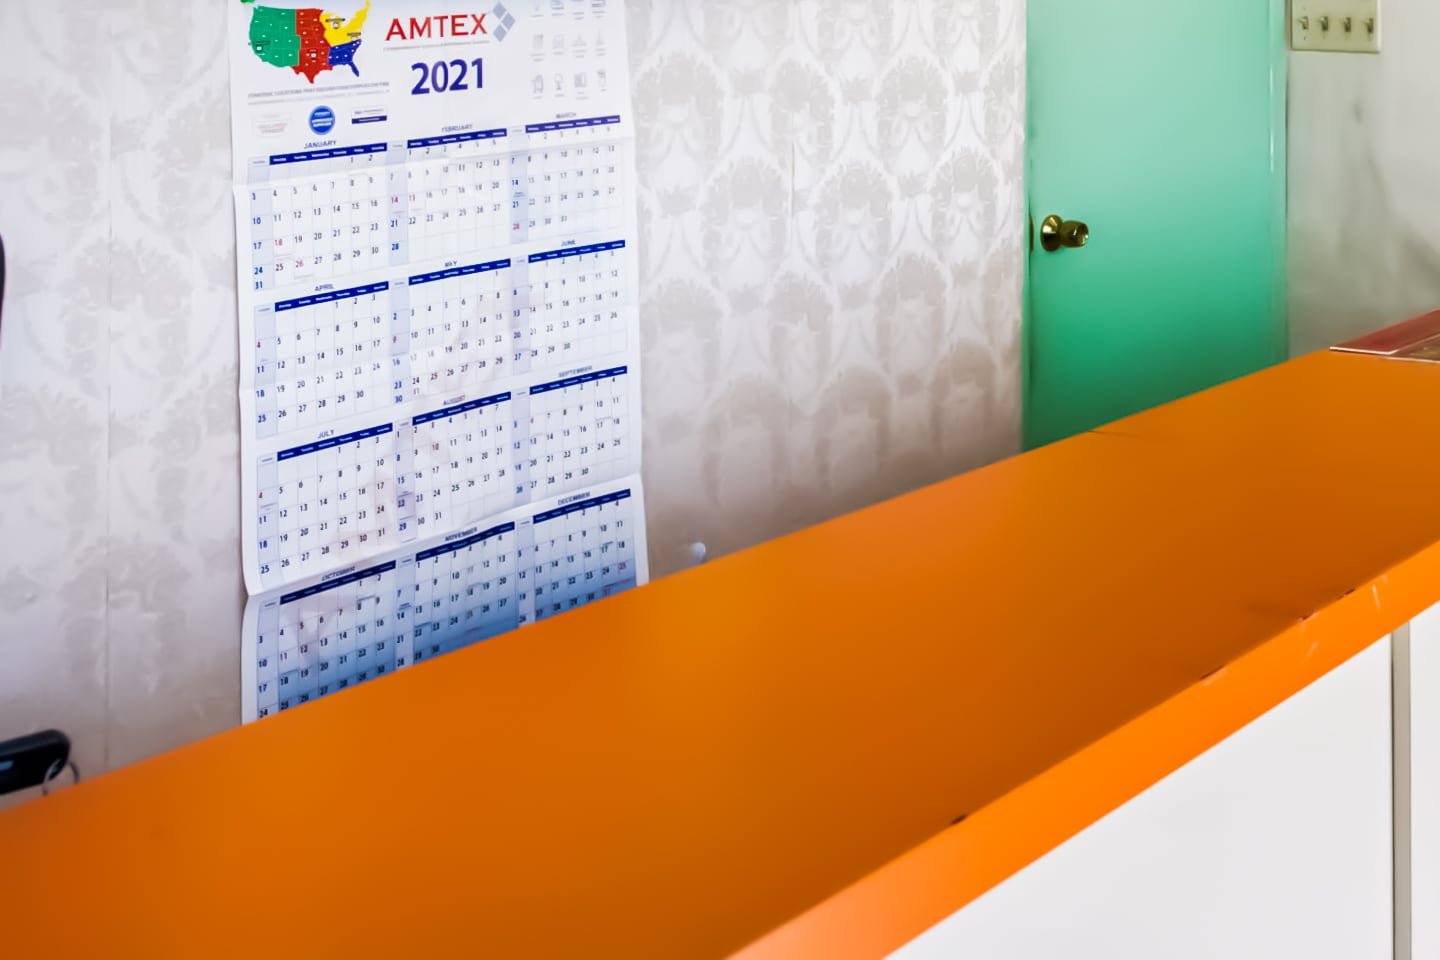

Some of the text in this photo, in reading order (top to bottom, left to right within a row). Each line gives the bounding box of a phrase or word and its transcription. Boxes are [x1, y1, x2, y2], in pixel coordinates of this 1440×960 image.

[384, 13, 487, 41] AMTEX
[411, 57, 483, 96] 2021
[304, 139, 337, 149] JANUARY
[252, 217, 261, 225] 10
[273, 214, 282, 222] 11
[294, 211, 302, 219] 12
[333, 205, 341, 213] 14
[314, 232, 322, 240] 20
[333, 229, 341, 237] 21
[352, 226, 360, 234] 22
[370, 223, 379, 231] 23
[254, 266, 263, 274] 24
[275, 263, 284, 271] 25
[295, 260, 304, 268] 26
[314, 256, 322, 264] 27
[333, 253, 342, 261] 28
[352, 250, 361, 258] 29
[314, 283, 335, 292] APRIL
[373, 316, 380, 324] 10
[277, 361, 285, 369] 12
[298, 356, 306, 364] 13
[317, 352, 325, 360] 14
[355, 344, 362, 352] 16
[256, 390, 265, 398] 18
[316, 376, 324, 384] 21
[258, 415, 267, 423] 25
[278, 410, 287, 418] 26
[318, 400, 326, 408] 28
[337, 395, 346, 403] 29
[317, 429, 334, 439] JULY
[376, 459, 384, 467] 10
[259, 516, 267, 524] 11
[300, 504, 308, 512] 13
[320, 498, 328, 506] 14
[376, 482, 384, 490] 17
[259, 540, 267, 549] 18
[280, 534, 288, 542] 19
[300, 528, 309, 536] 20
[358, 511, 366, 519] 23
[376, 506, 385, 514] 24
[260, 565, 270, 574] 25
[281, 559, 290, 567] 26
[301, 552, 310, 561] 27
[321, 546, 330, 554] 28
[341, 540, 349, 549] 29
[359, 534, 368, 542] 30
